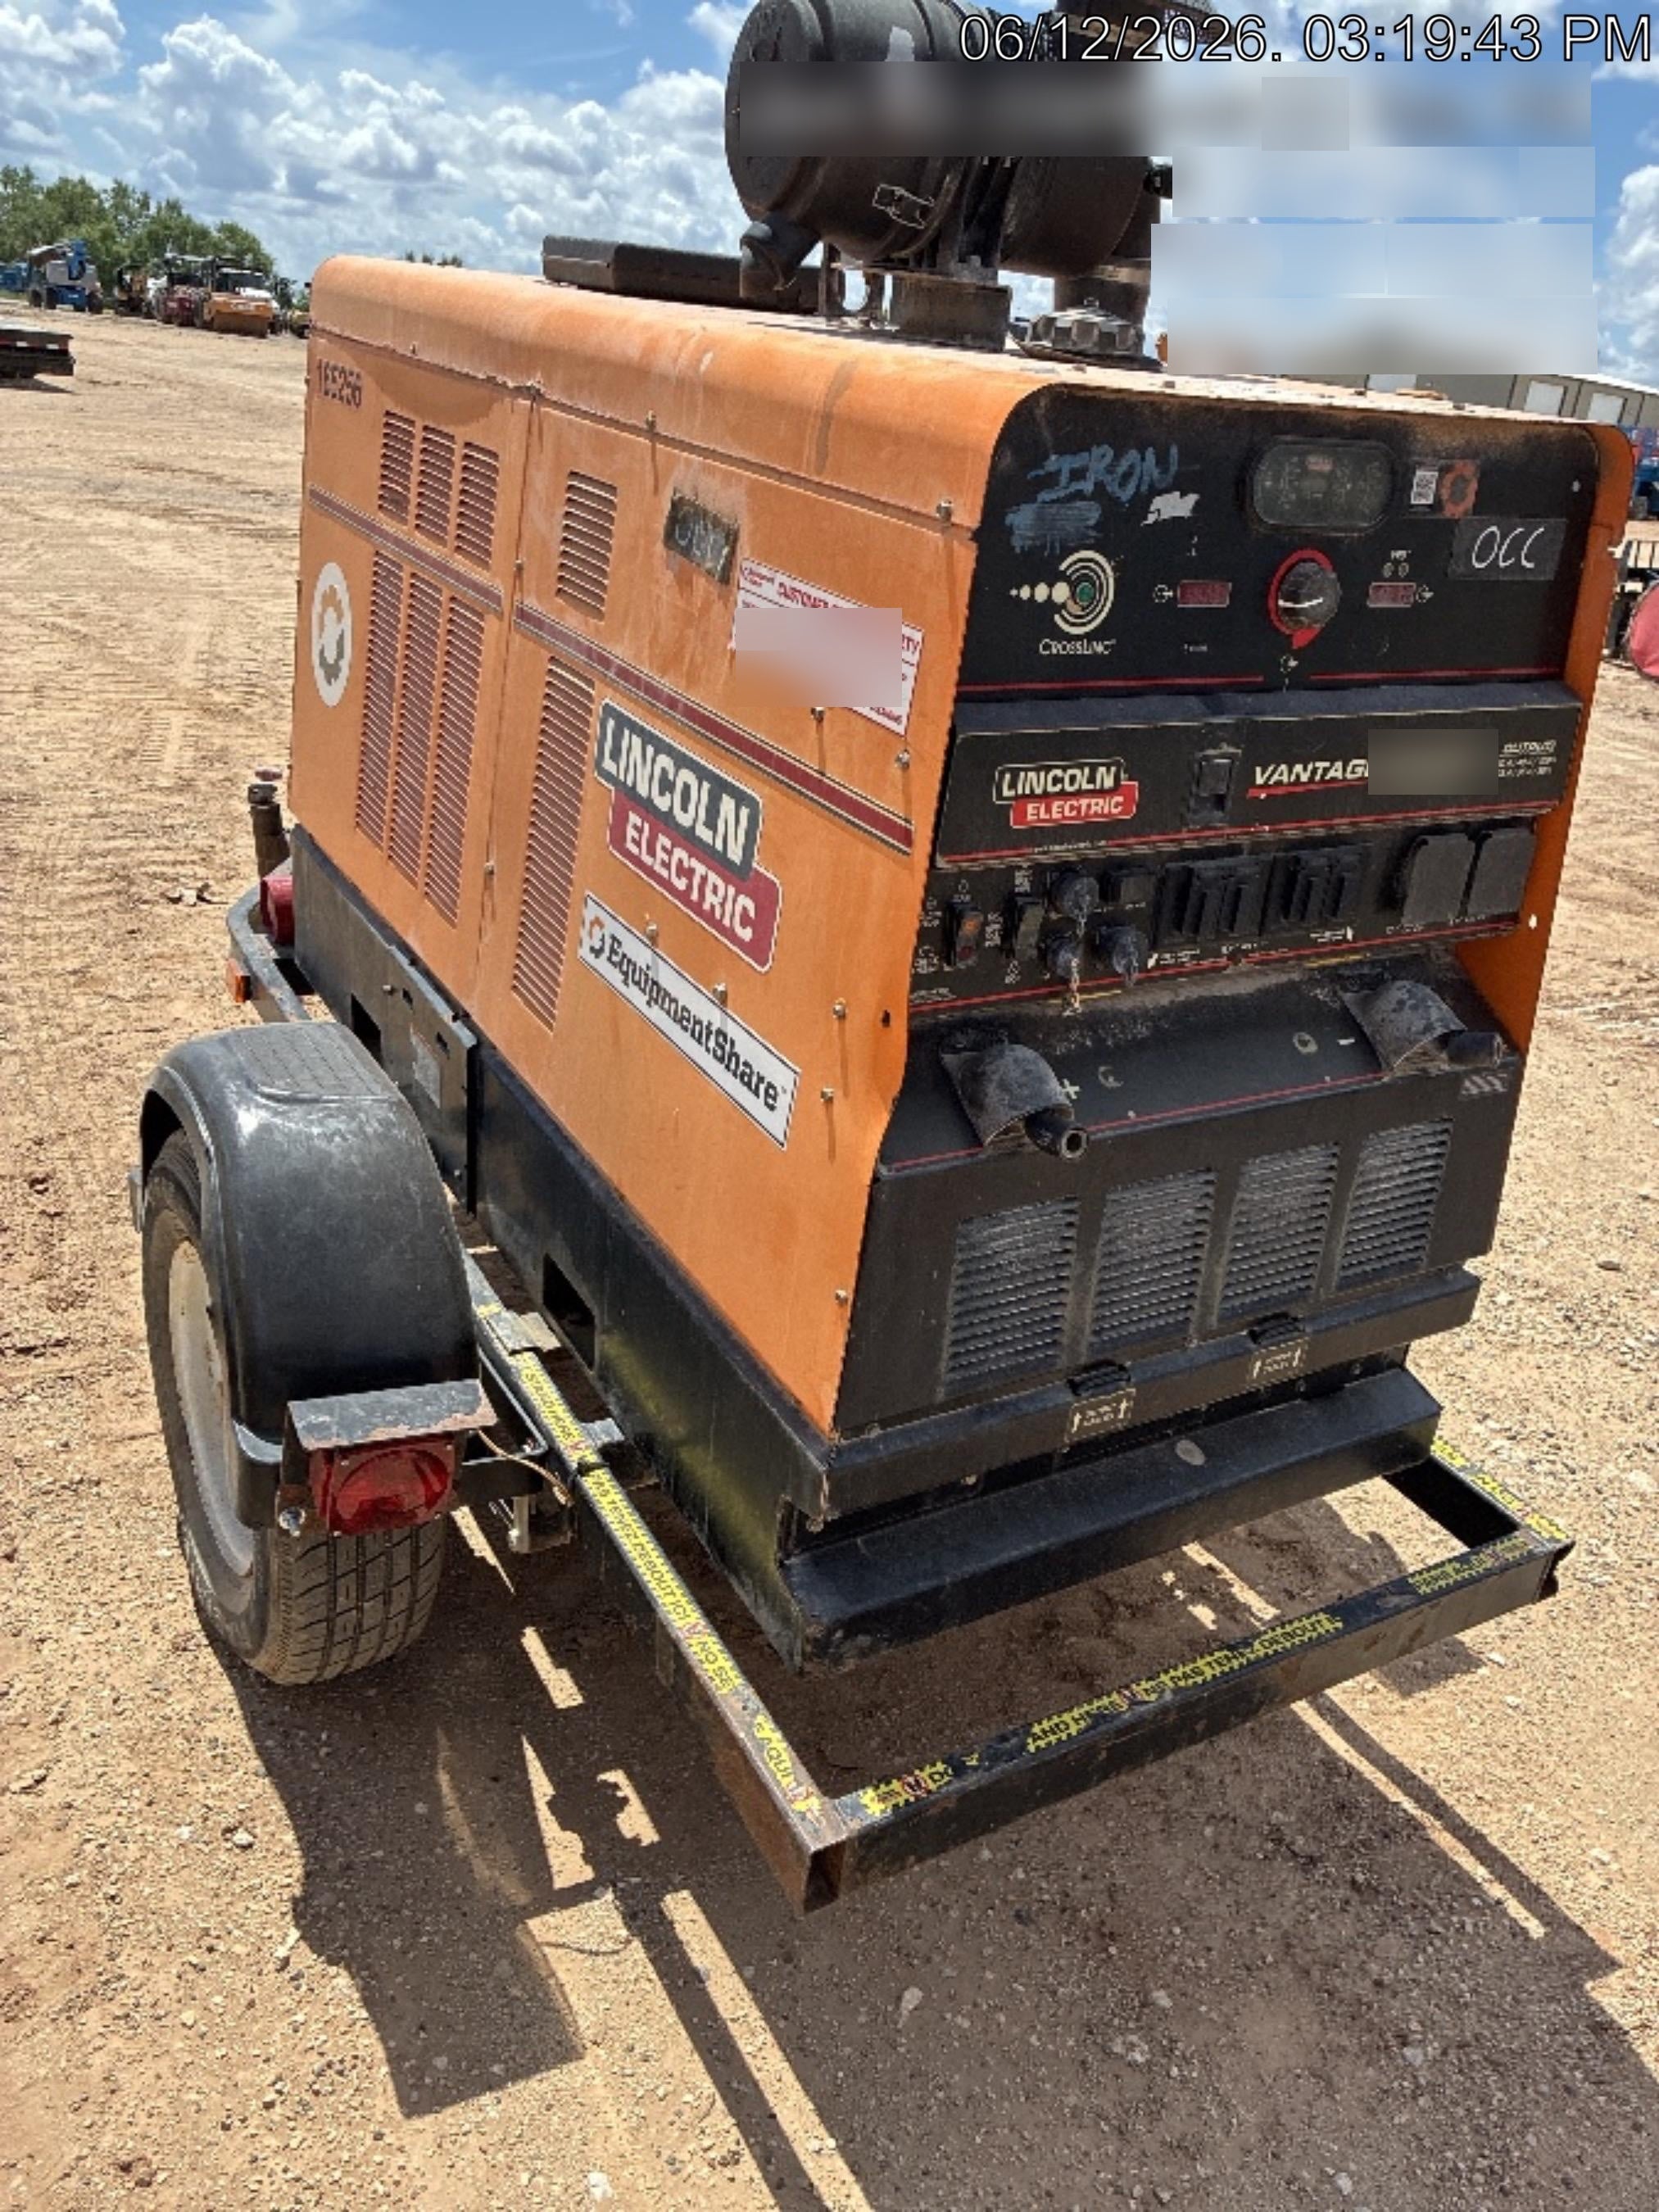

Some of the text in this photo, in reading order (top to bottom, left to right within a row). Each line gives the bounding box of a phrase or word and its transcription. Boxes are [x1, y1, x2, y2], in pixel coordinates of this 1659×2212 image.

[1027, 443, 1179, 503] IRON
[601, 717, 750, 866] LINCOLN
[1001, 766, 1117, 798] LINCOLN
[1254, 759, 1369, 786] VANTAG
[1027, 796, 1125, 822] ELECTRIC
[625, 810, 756, 942] ELECTRIC
[1258, 1620, 1326, 1652] DEBOUT
[696, 1639, 734, 1689] NO SE
